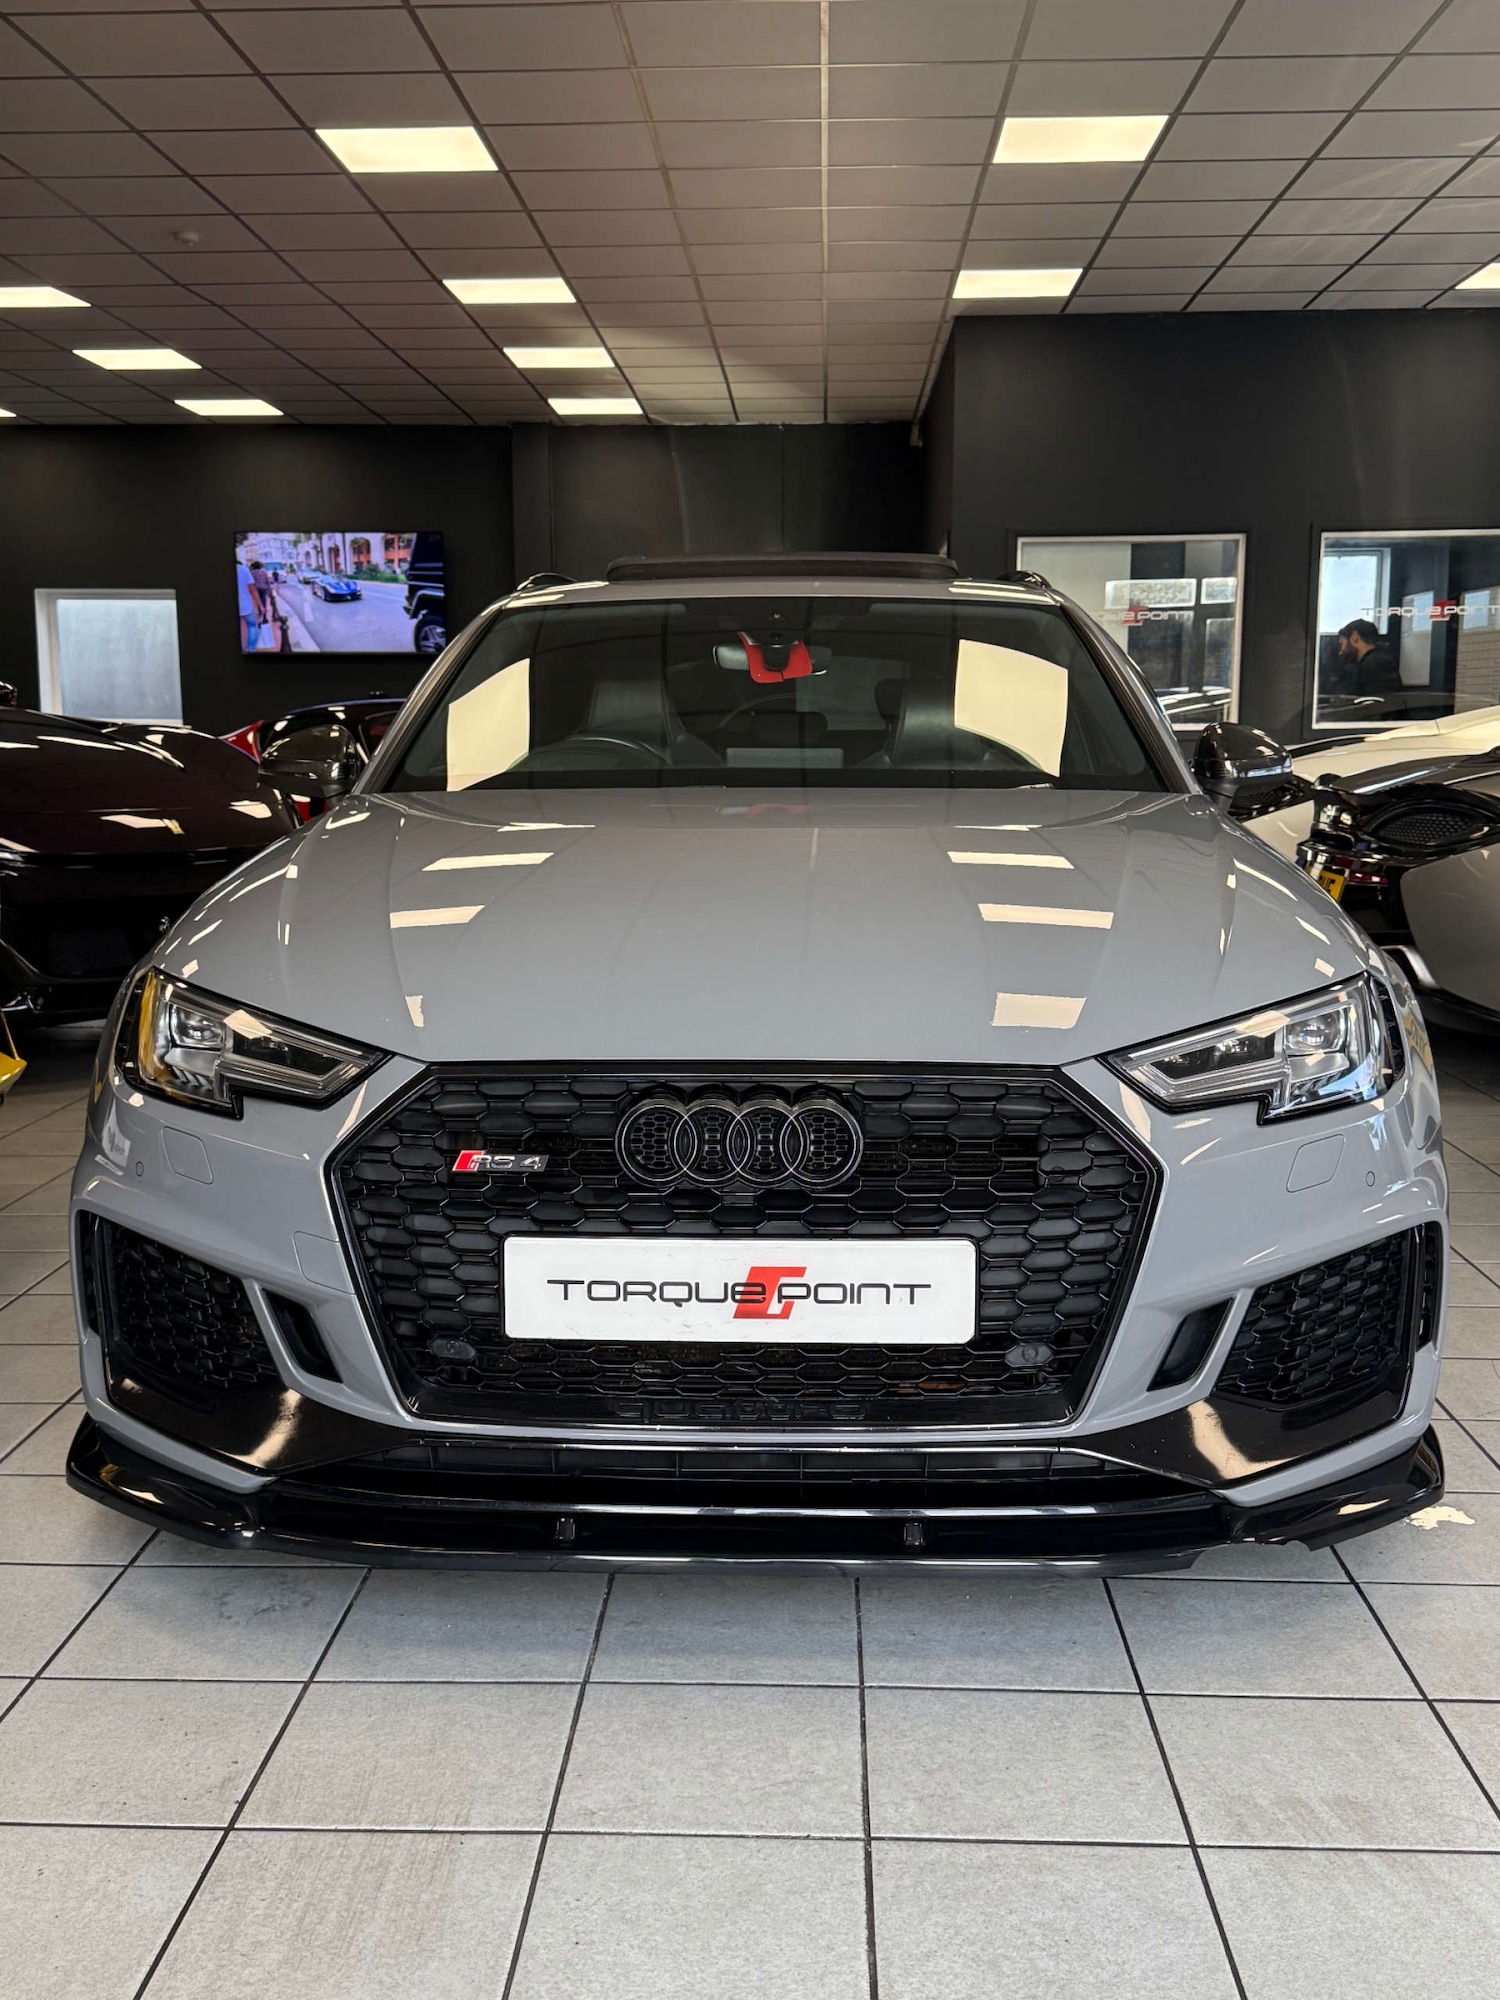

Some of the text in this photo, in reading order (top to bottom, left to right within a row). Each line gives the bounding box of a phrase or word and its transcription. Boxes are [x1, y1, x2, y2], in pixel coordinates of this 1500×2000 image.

[1136, 610, 1195, 621] POINT
[1360, 604, 1500, 618] TORQUE POINT
[546, 1279, 932, 1308] TORQUE POINT
